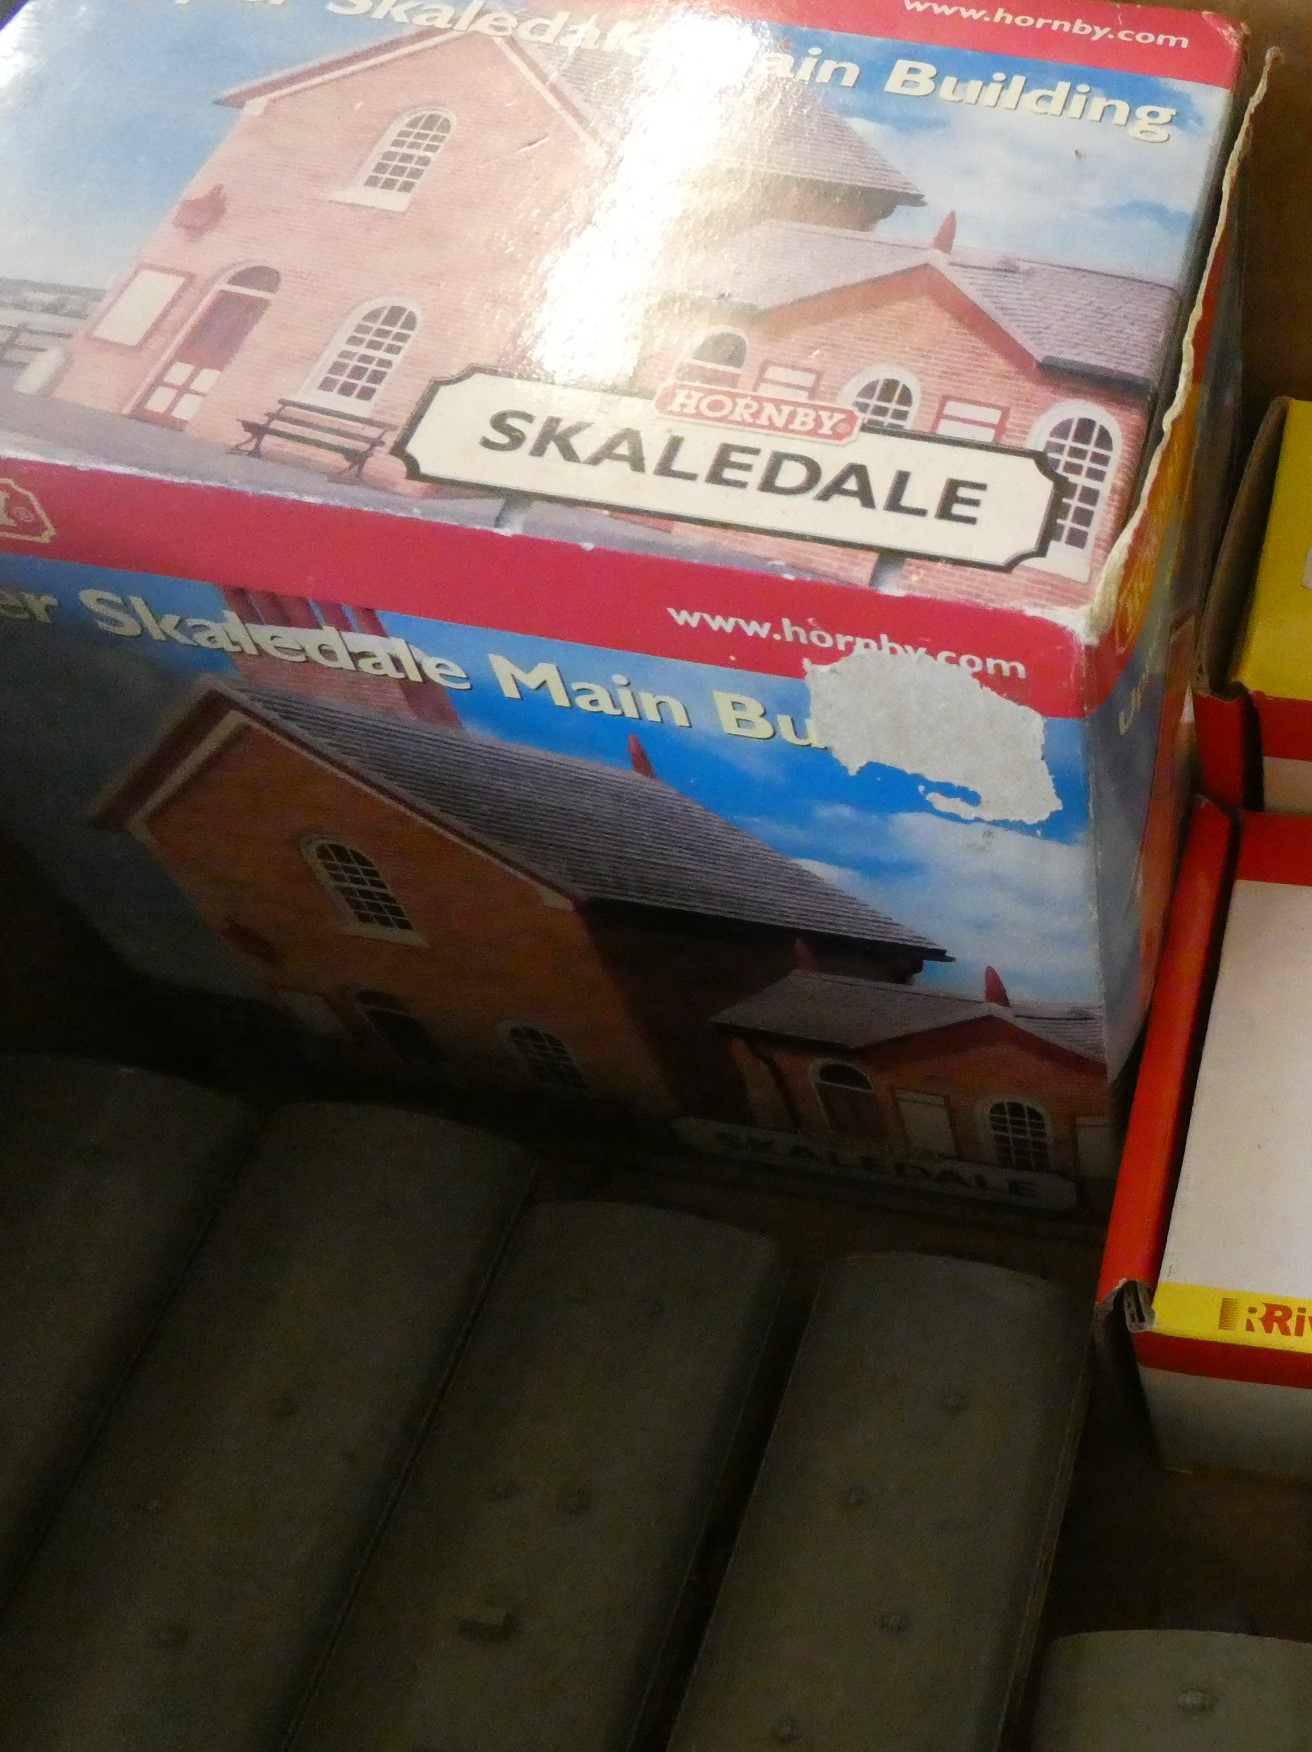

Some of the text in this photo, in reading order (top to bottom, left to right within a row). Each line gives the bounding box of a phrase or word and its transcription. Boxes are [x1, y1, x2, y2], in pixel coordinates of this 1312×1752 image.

[904, 0, 1189, 49] www.hornby.com
[884, 59, 1178, 144] Building
[667, 387, 840, 438] HORNBY
[479, 408, 989, 527] SKALEDALE
[78, 588, 473, 691] Skaledale
[488, 652, 693, 729] Main
[666, 606, 1027, 679] www.hornbycom
